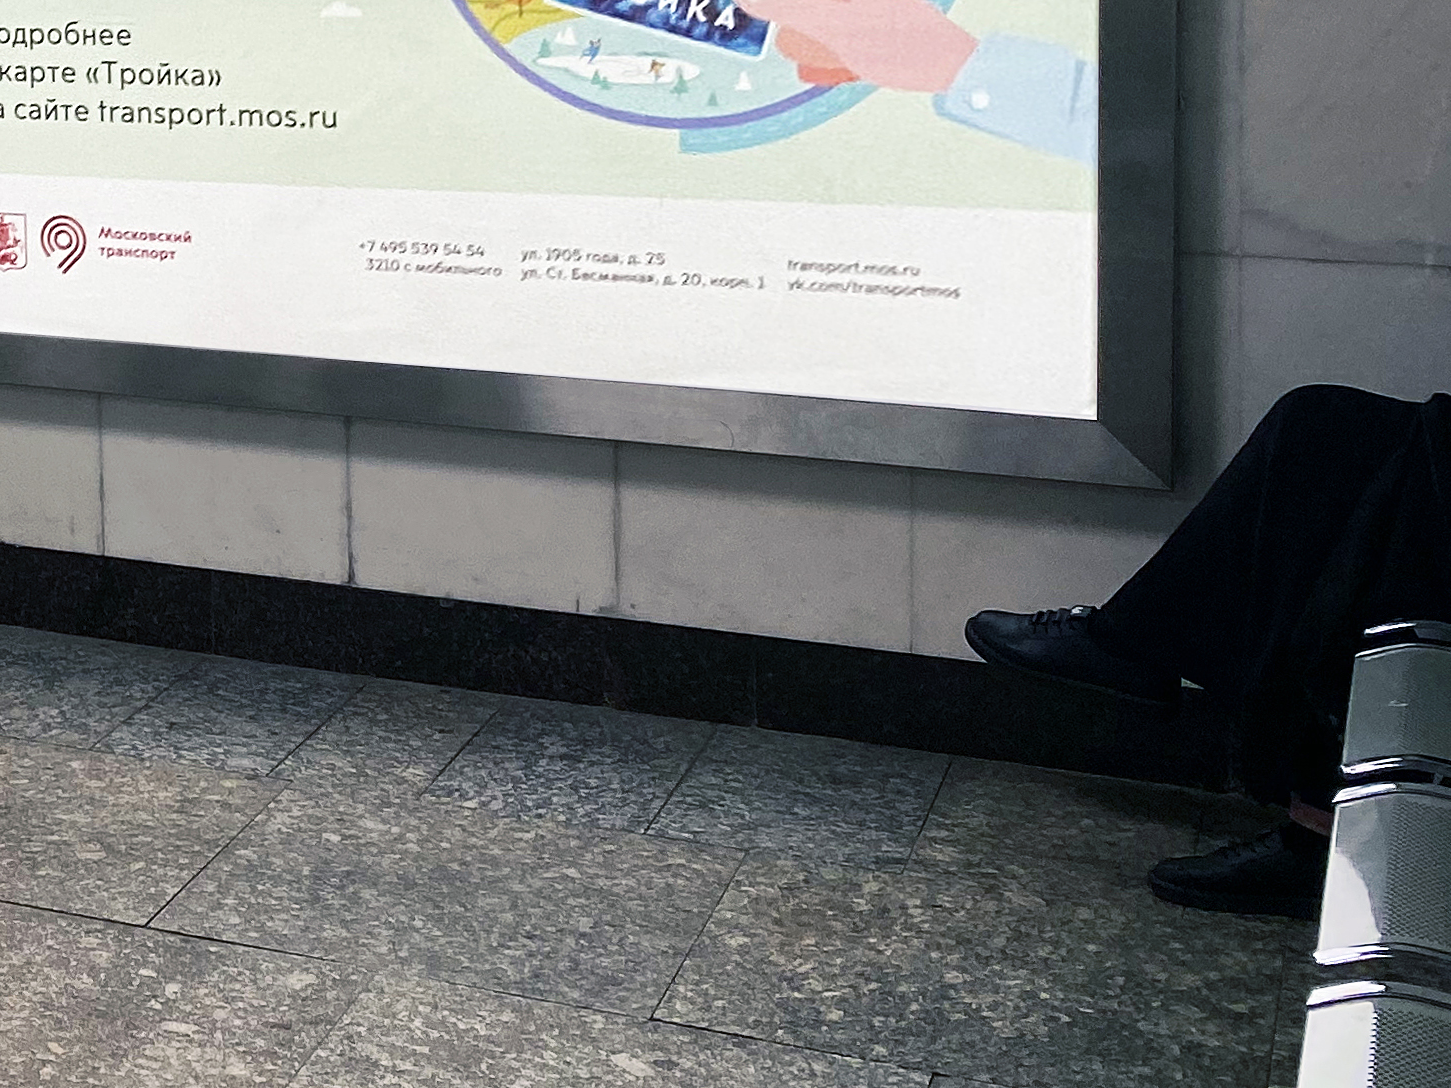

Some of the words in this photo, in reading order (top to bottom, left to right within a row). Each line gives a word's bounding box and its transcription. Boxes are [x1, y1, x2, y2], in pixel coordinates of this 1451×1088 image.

[0, 63, 76, 87] карте
[86, 60, 222, 89] «Тройка»
[14, 98, 89, 122] сайте
[98, 100, 338, 130] transport.mos.ru
[98, 226, 192, 243] Московский
[99, 245, 176, 261] транспорт
[380, 241, 407, 254] 495
[411, 242, 438, 255] 539
[443, 243, 461, 256] 54
[466, 244, 485, 257] 54
[546, 248, 582, 261] 1905
